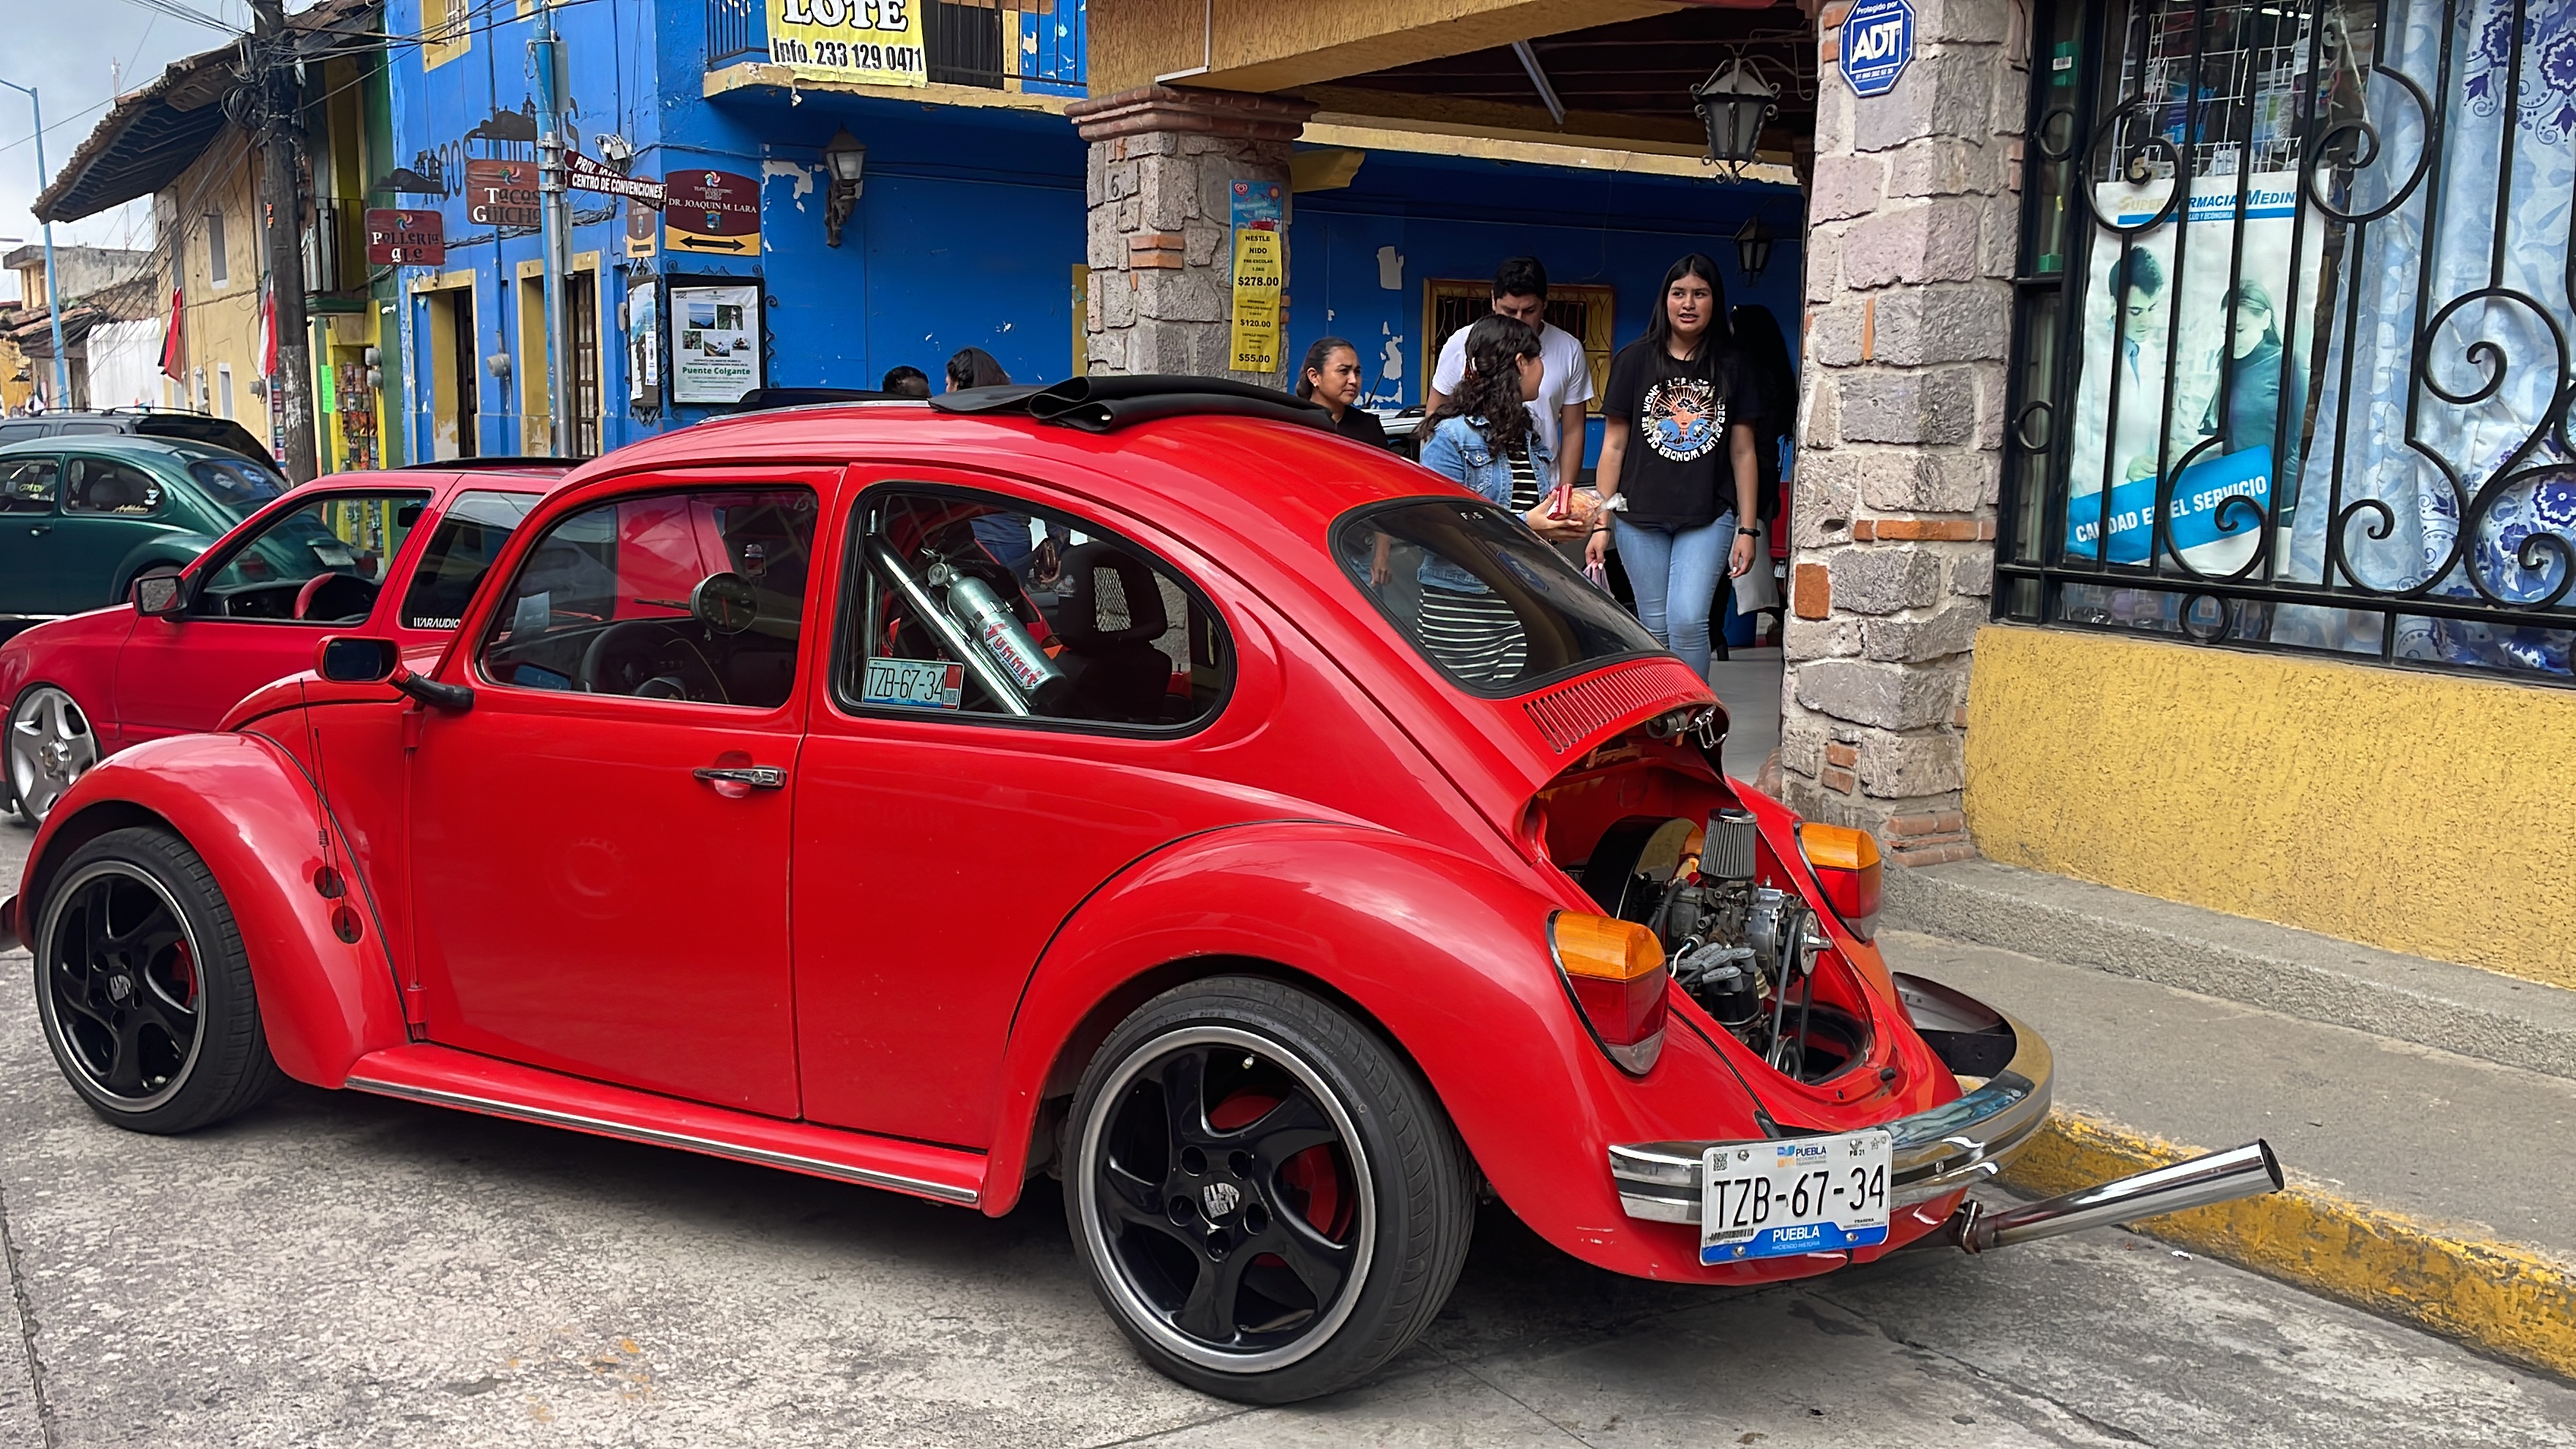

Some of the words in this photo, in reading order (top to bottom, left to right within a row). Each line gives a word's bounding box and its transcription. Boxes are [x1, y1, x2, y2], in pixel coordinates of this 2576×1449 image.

[1887, 1, 1898, 10] por
[782, 0, 908, 31] LOTE
[1852, 20, 1901, 64] ADT
[773, 38, 813, 64] Info.
[815, 41, 848, 67] 233
[852, 44, 882, 70] 129
[886, 46, 923, 72] 0471
[572, 173, 599, 190] CENTRO
[600, 177, 610, 191] DE
[611, 179, 663, 199] CONVENCIONES
[668, 198, 682, 207] DR.
[684, 200, 722, 210] JOAQUIN
[734, 204, 757, 213] LARA
[2188, 195, 2237, 208] RMACIA
[2247, 190, 2296, 206] MEDIN
[1238, 276, 1278, 286] $278.00
[1240, 318, 1271, 328] $120.00
[1238, 353, 1270, 363] $55.00
[714, 367, 751, 375] Colgante
[1658, 445, 1701, 462] WONDER
[1699, 435, 1718, 454] LIFE
[2075, 511, 2138, 542] CADAD
[2171, 498, 2190, 518] EL
[2193, 476, 2267, 513] SERVICIO
[869, 667, 946, 701] TZB-67-34
[1796, 1145, 1827, 1157] PUEBLA
[1713, 1164, 1884, 1229] TZB-67-34
[1772, 1225, 1820, 1243] PUEBLA
